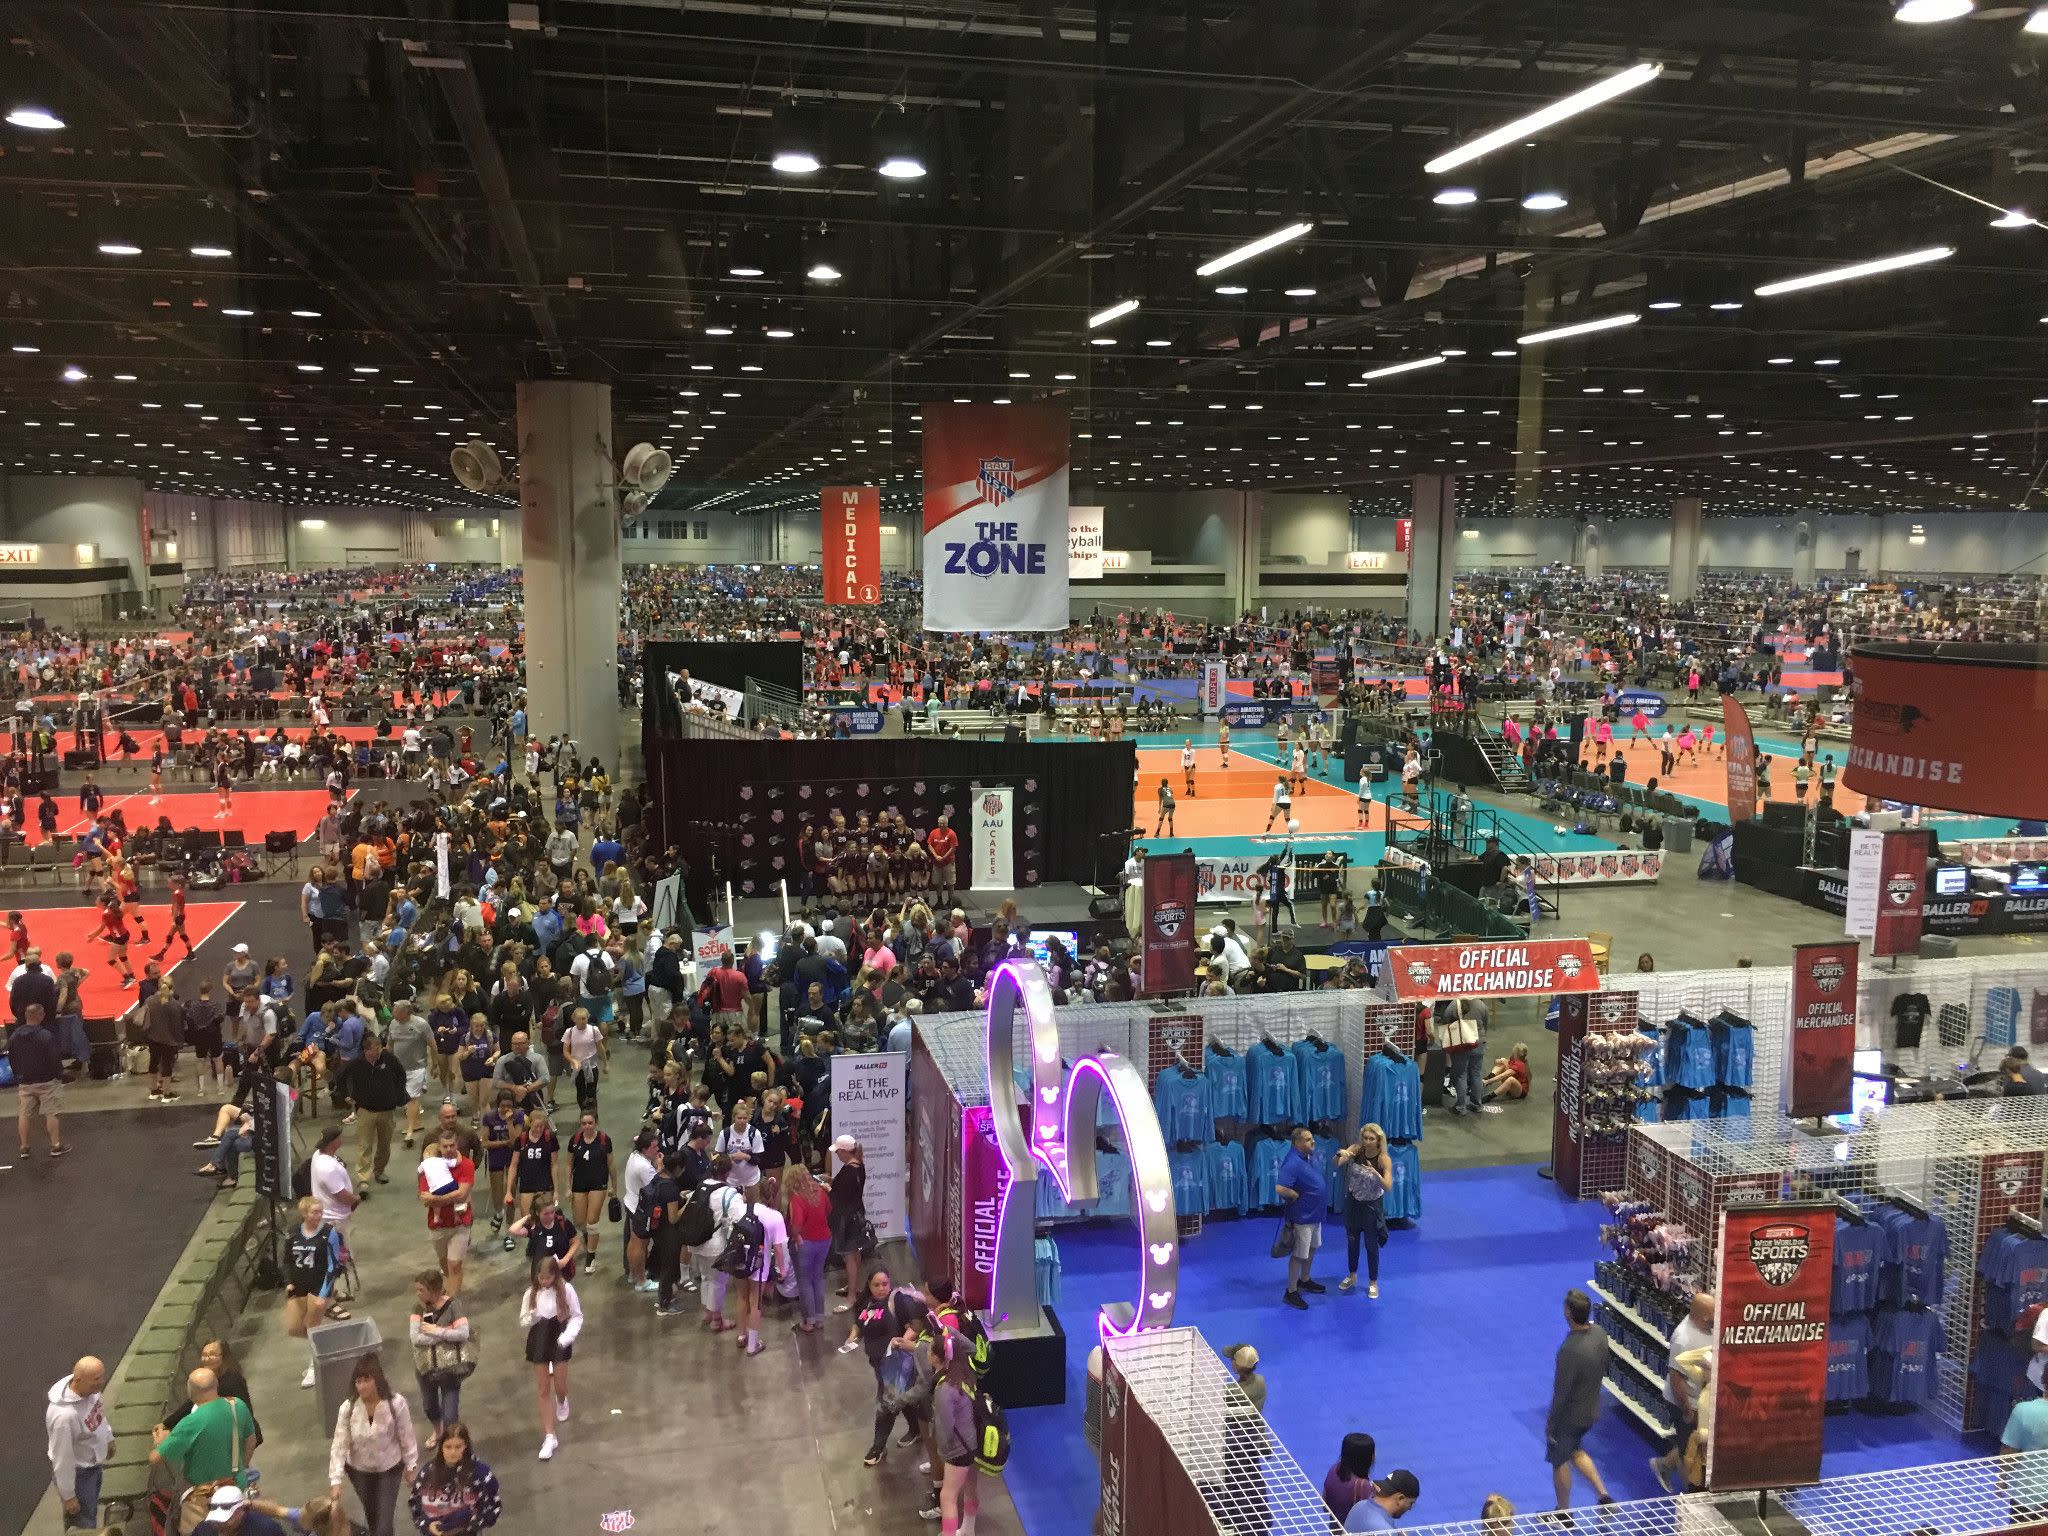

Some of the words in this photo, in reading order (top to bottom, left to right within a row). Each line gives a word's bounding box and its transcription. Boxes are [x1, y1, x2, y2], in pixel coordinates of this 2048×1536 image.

[984, 472, 1008, 495] USA
[975, 522, 1018, 541] THE
[1080, 525, 1098, 533] the
[842, 491, 859, 599] MEDICAL
[1068, 536, 1102, 549] yball
[944, 541, 1046, 577] ZONE
[1102, 556, 1123, 568] XIT
[1353, 556, 1380, 568] EXIT
[1209, 668, 1218, 707] TARAFLEX
[982, 820, 1003, 828] AAU
[989, 830, 997, 875] CARES
[1222, 862, 1239, 874] AAU
[1887, 883, 1916, 891] SPORTS
[1153, 912, 1186, 923] SPORTS
[1459, 948, 1530, 969] OFFICIAL
[1812, 966, 1845, 977] SPORTS
[1437, 969, 1553, 992] MERCHANDISE
[1808, 1002, 1844, 1016] OFFICIAL
[1796, 1014, 1854, 1029] MERCHANDISE
[848, 1079, 864, 1090] BE
[866, 1077, 889, 1089] THE
[1560, 1054, 1571, 1115] OFFICIAL
[1568, 1035, 1582, 1144] MERCHANDISE
[838, 1090, 870, 1102] REAL
[872, 1088, 899, 1099] MVP
[582, 1150, 591, 1161] 4
[974, 1196, 996, 1274] OFFICIAL
[1765, 1227, 1794, 1238] ESPN
[1754, 1239, 1773, 1247] WIDE
[292, 1250, 316, 1269] 24
[1751, 1245, 1808, 1260] SPORTS
[1743, 1301, 1807, 1322] OFFICIAL
[1721, 1322, 1825, 1345] MERCHANDISE
